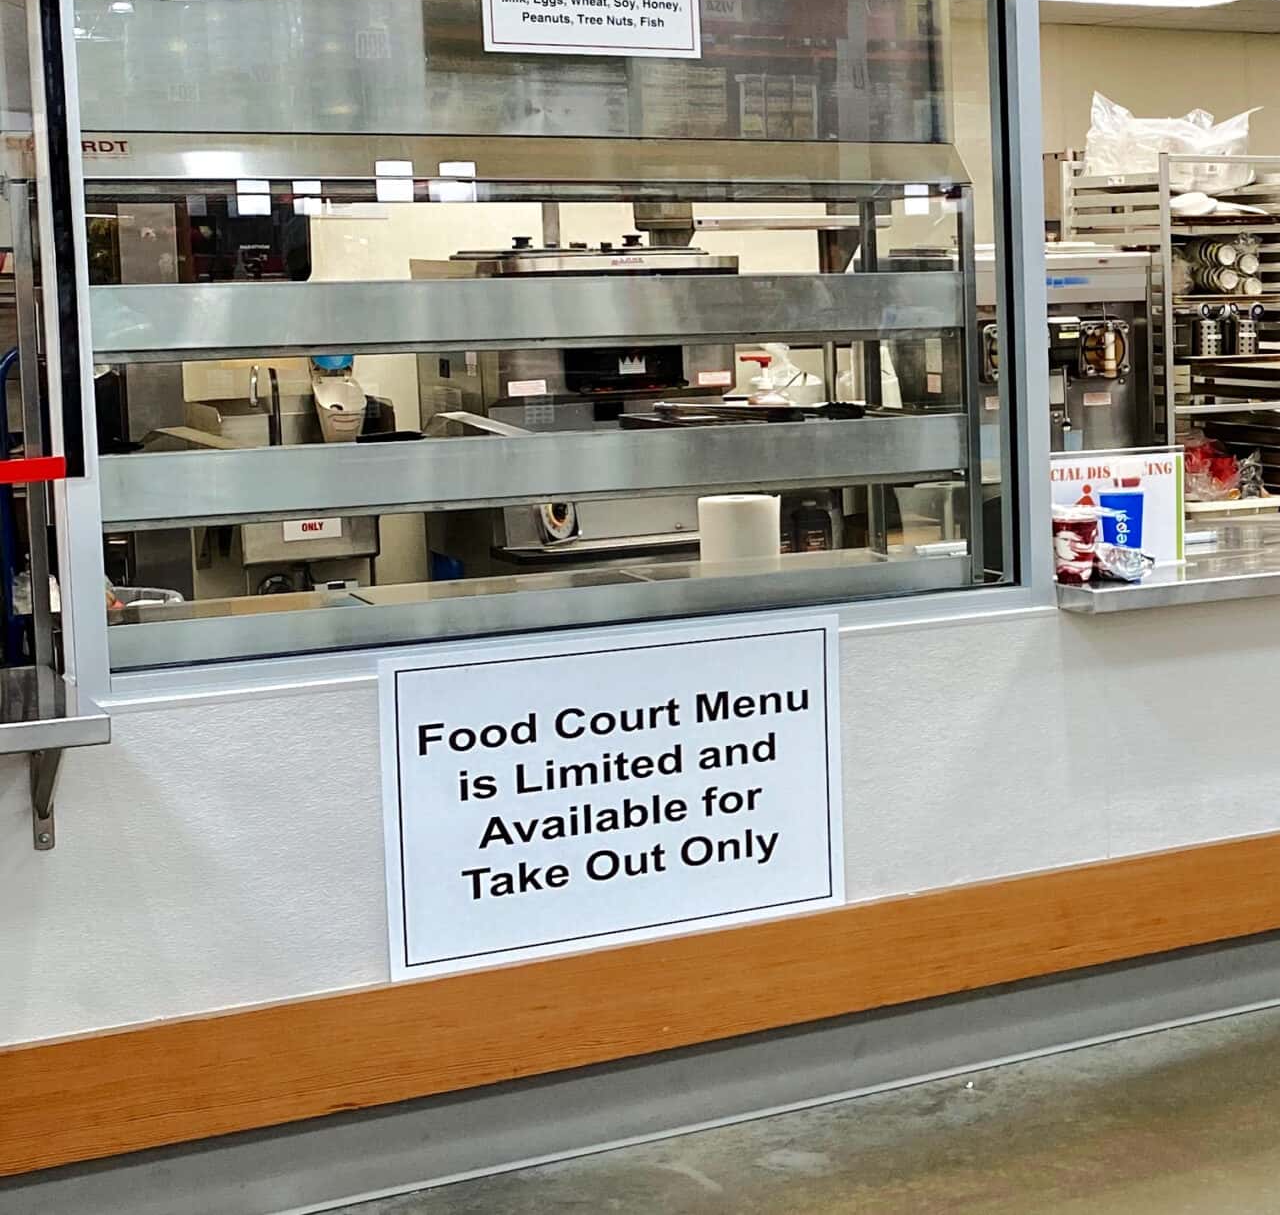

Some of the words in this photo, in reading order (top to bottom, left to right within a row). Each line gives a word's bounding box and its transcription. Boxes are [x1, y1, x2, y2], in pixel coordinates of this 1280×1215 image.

[522, 12, 574, 26] Peanuts,
[577, 14, 603, 26] Tree
[606, 15, 637, 28] Nuts,
[640, 16, 665, 28] Fish
[302, 522, 324, 532] ONLY
[417, 713, 538, 756] Food
[555, 698, 680, 739] Court
[696, 689, 809, 723] Menu
[459, 770, 497, 802] is
[516, 744, 683, 795] Limited
[699, 732, 777, 769] and
[479, 794, 688, 850] Available
[702, 786, 763, 817] for
[461, 862, 570, 901] Take
[586, 844, 666, 882] Out
[681, 829, 780, 868] Only
